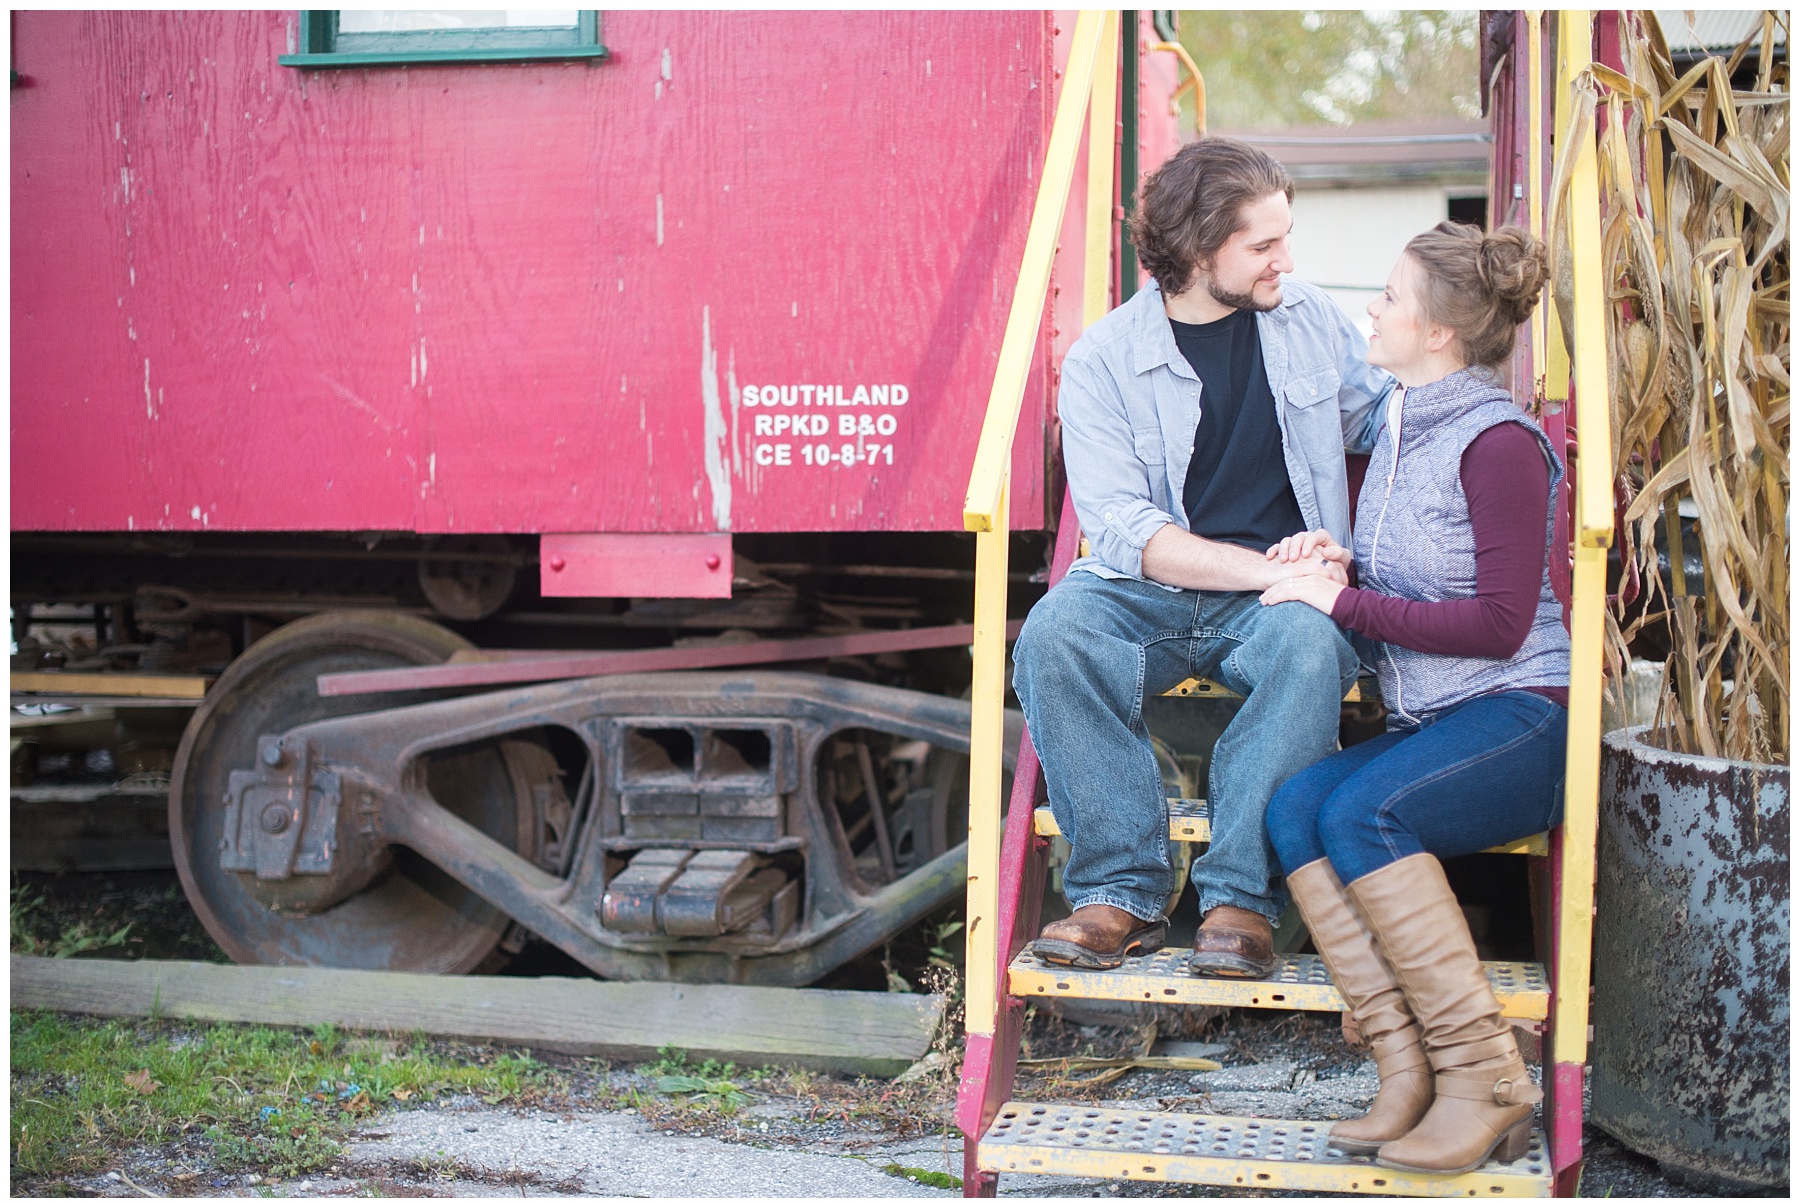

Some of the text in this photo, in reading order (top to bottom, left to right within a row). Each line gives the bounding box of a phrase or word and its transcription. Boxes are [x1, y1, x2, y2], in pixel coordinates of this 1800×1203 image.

[742, 384, 909, 407] SOUTHLAND
[755, 413, 897, 436] RPKD B&O
[755, 443, 894, 466] CE 10-8-71
